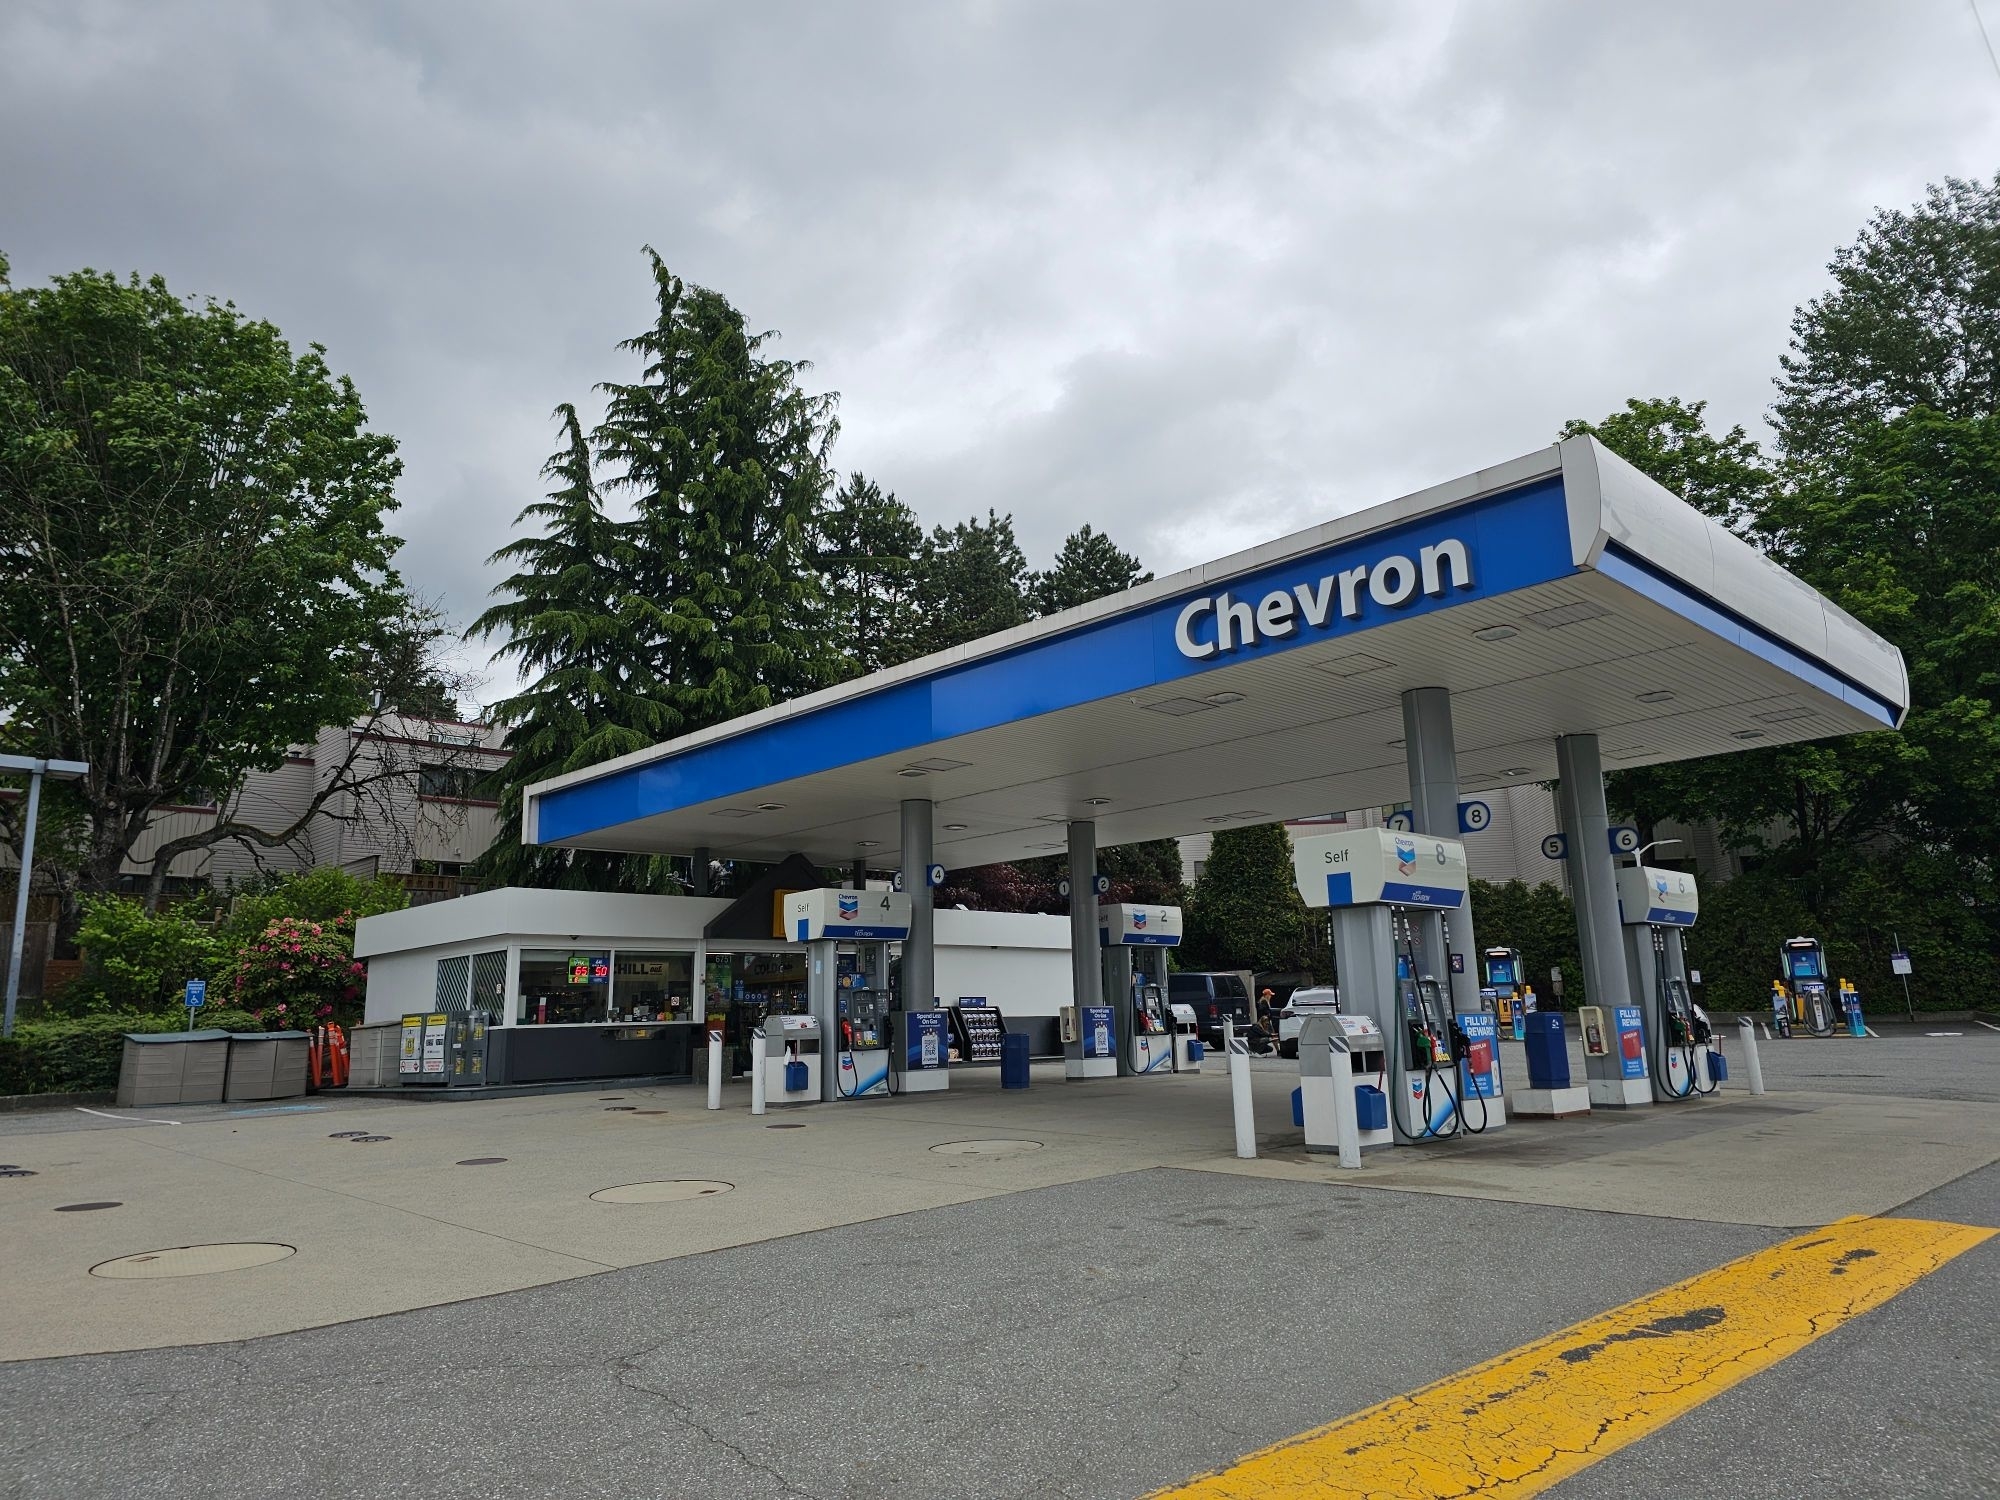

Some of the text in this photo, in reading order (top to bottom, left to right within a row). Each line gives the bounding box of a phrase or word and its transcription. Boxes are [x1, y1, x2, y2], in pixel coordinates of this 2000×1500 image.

[1175, 538, 1473, 659] Chevron
[1471, 809, 1482, 823] 8
[1394, 819, 1404, 831] 7
[1621, 833, 1632, 846] 6
[1549, 841, 1559, 853] 5
[1324, 849, 1349, 864] Self
[1435, 843, 1446, 865] 8
[934, 869, 942, 880] 4
[1062, 883, 1067, 894] 1
[1100, 879, 1107, 889] 2
[1678, 877, 1685, 894] 6
[797, 903, 809, 913] Self
[879, 895, 891, 911] 4
[1160, 909, 1168, 923] 2
[575, 966, 588, 976] 65
[595, 966, 608, 976] 50
[614, 963, 649, 975] HILL
[1619, 1009, 1631, 1018] FILL
[1464, 1016, 1480, 1026] FILL
[1480, 1016, 1488, 1026] UP
